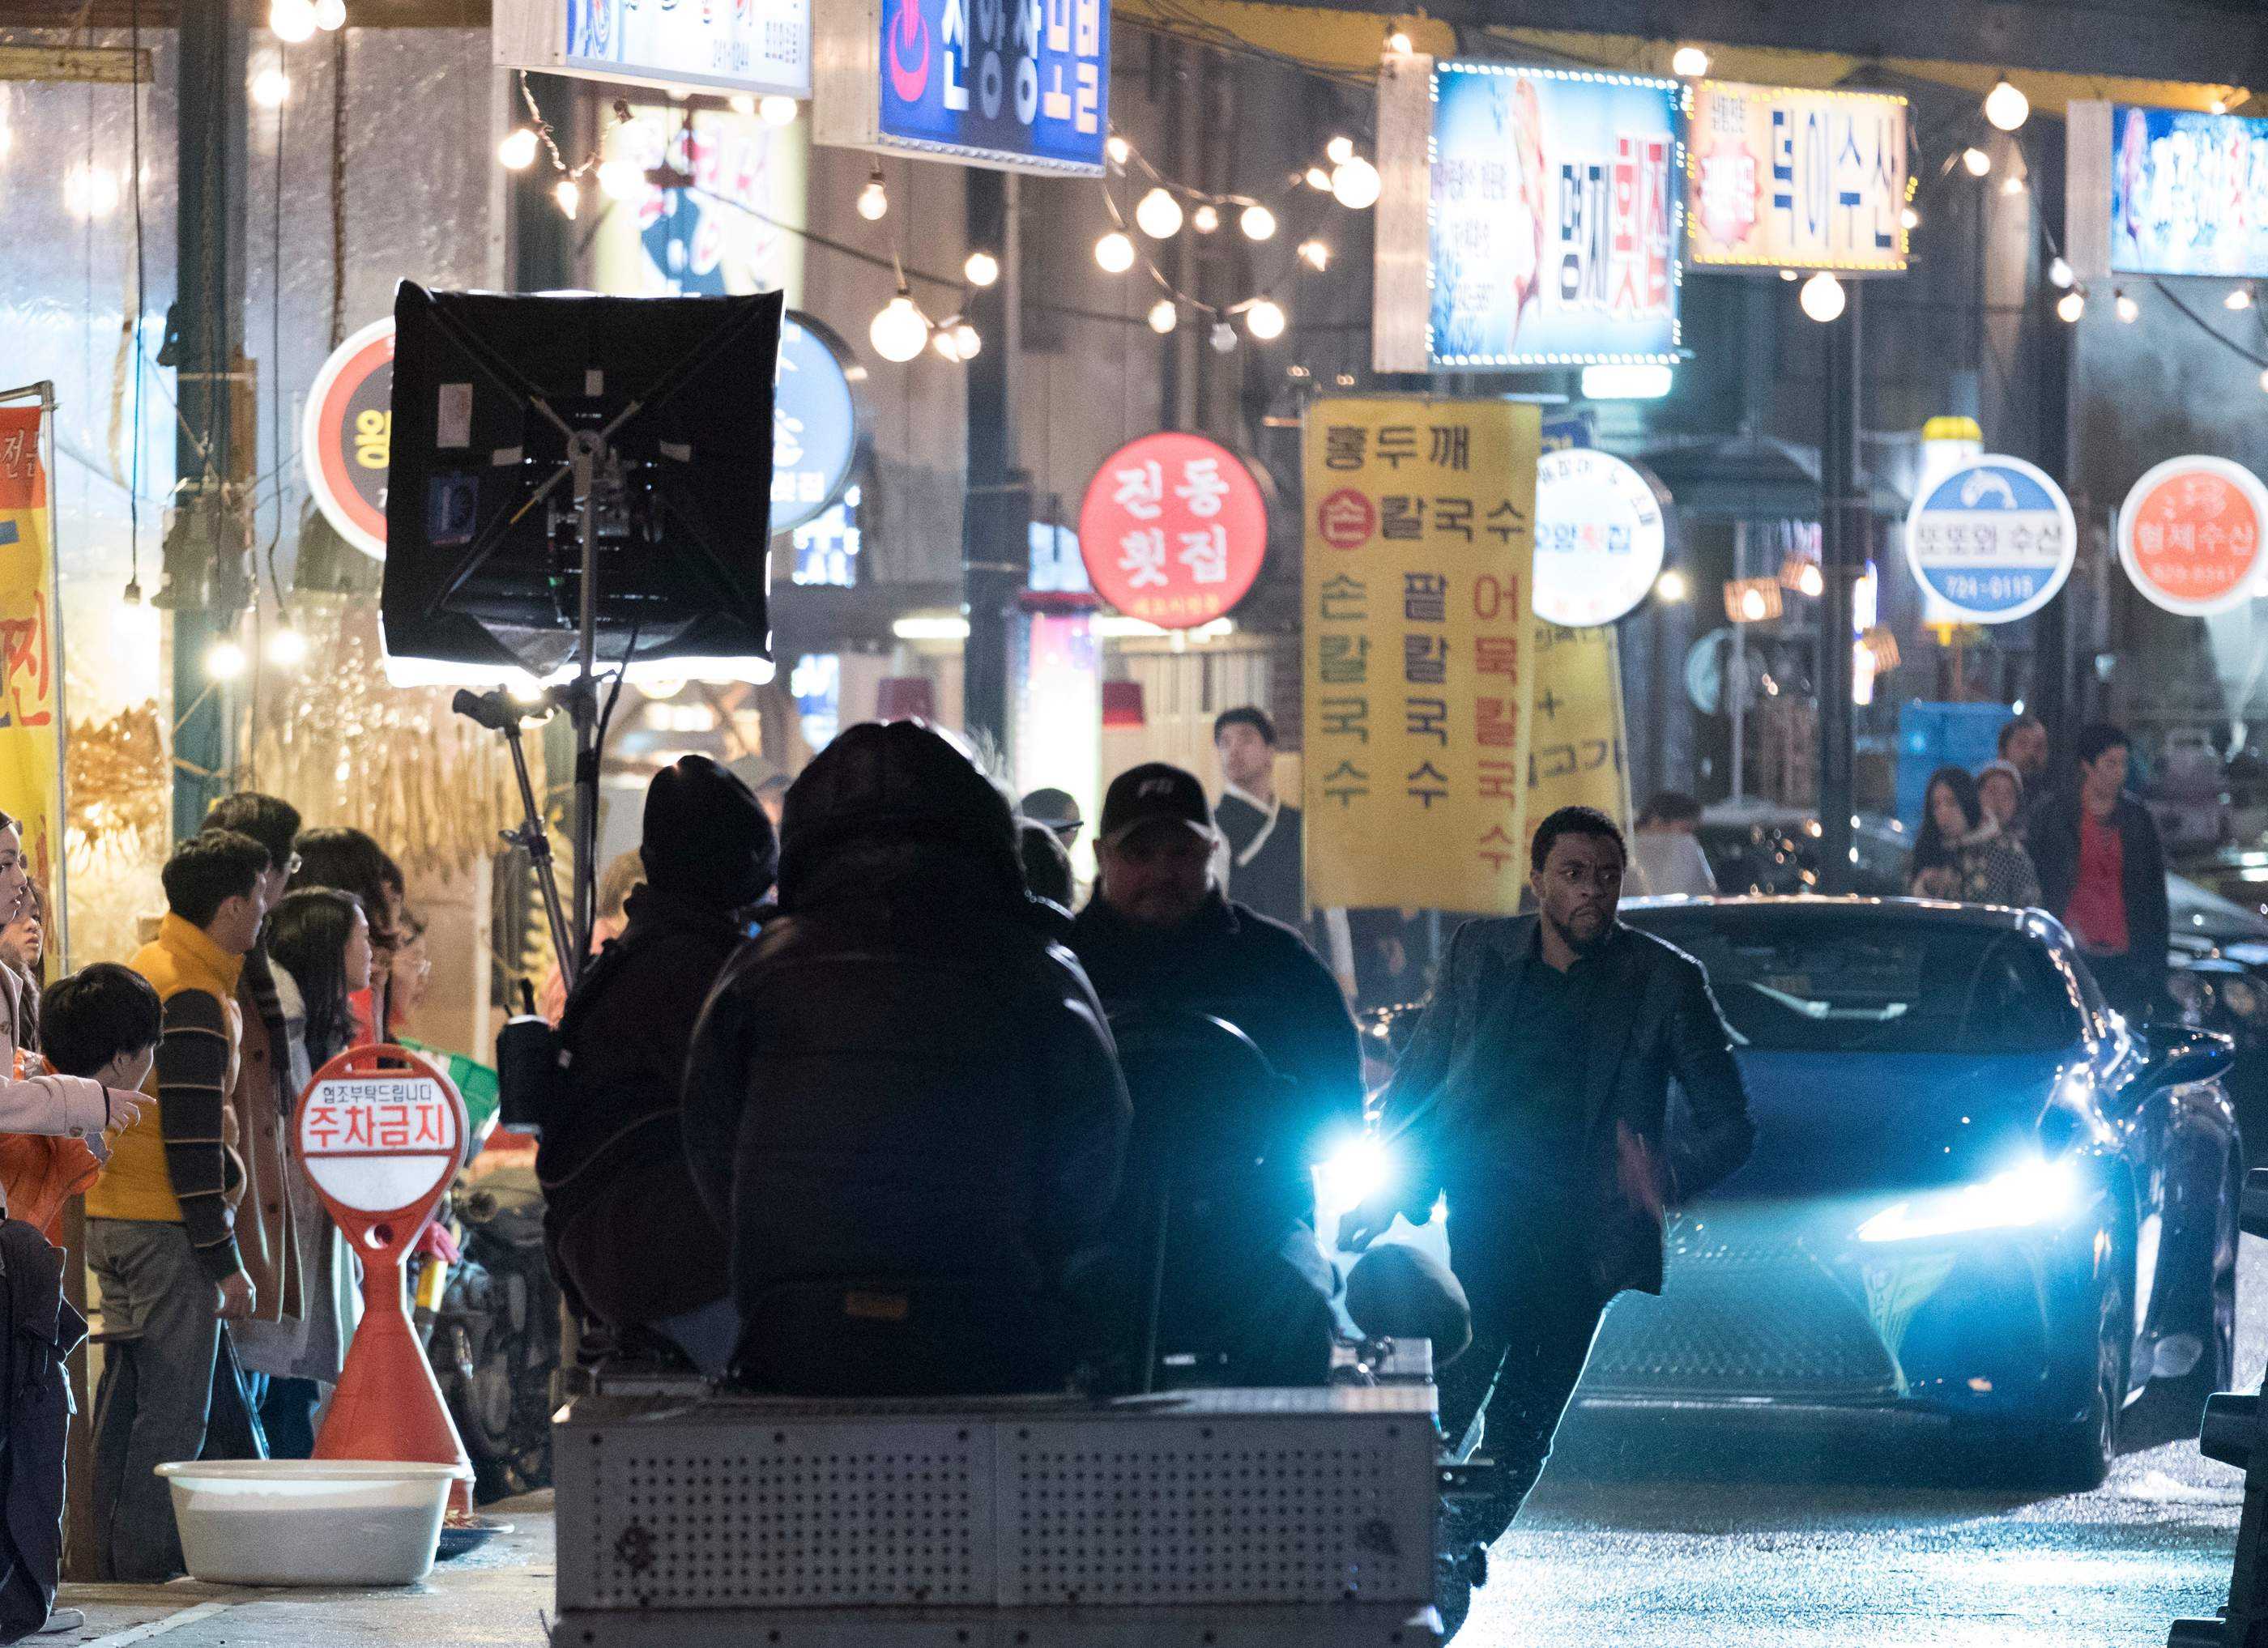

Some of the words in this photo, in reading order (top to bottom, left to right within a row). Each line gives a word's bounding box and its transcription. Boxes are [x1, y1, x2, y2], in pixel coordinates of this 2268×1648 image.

[1326, 426, 1470, 471] 홍두깨
[1114, 458, 1230, 520] 진동
[1325, 496, 1525, 543] 손칼국수
[1117, 523, 1229, 589] 횟집
[1319, 573, 1371, 810] 손칼국수
[1404, 571, 1449, 810] 팥칼국수
[322, 1083, 433, 1105] 협조부탁드립니다
[309, 1104, 446, 1148] 주차금지
